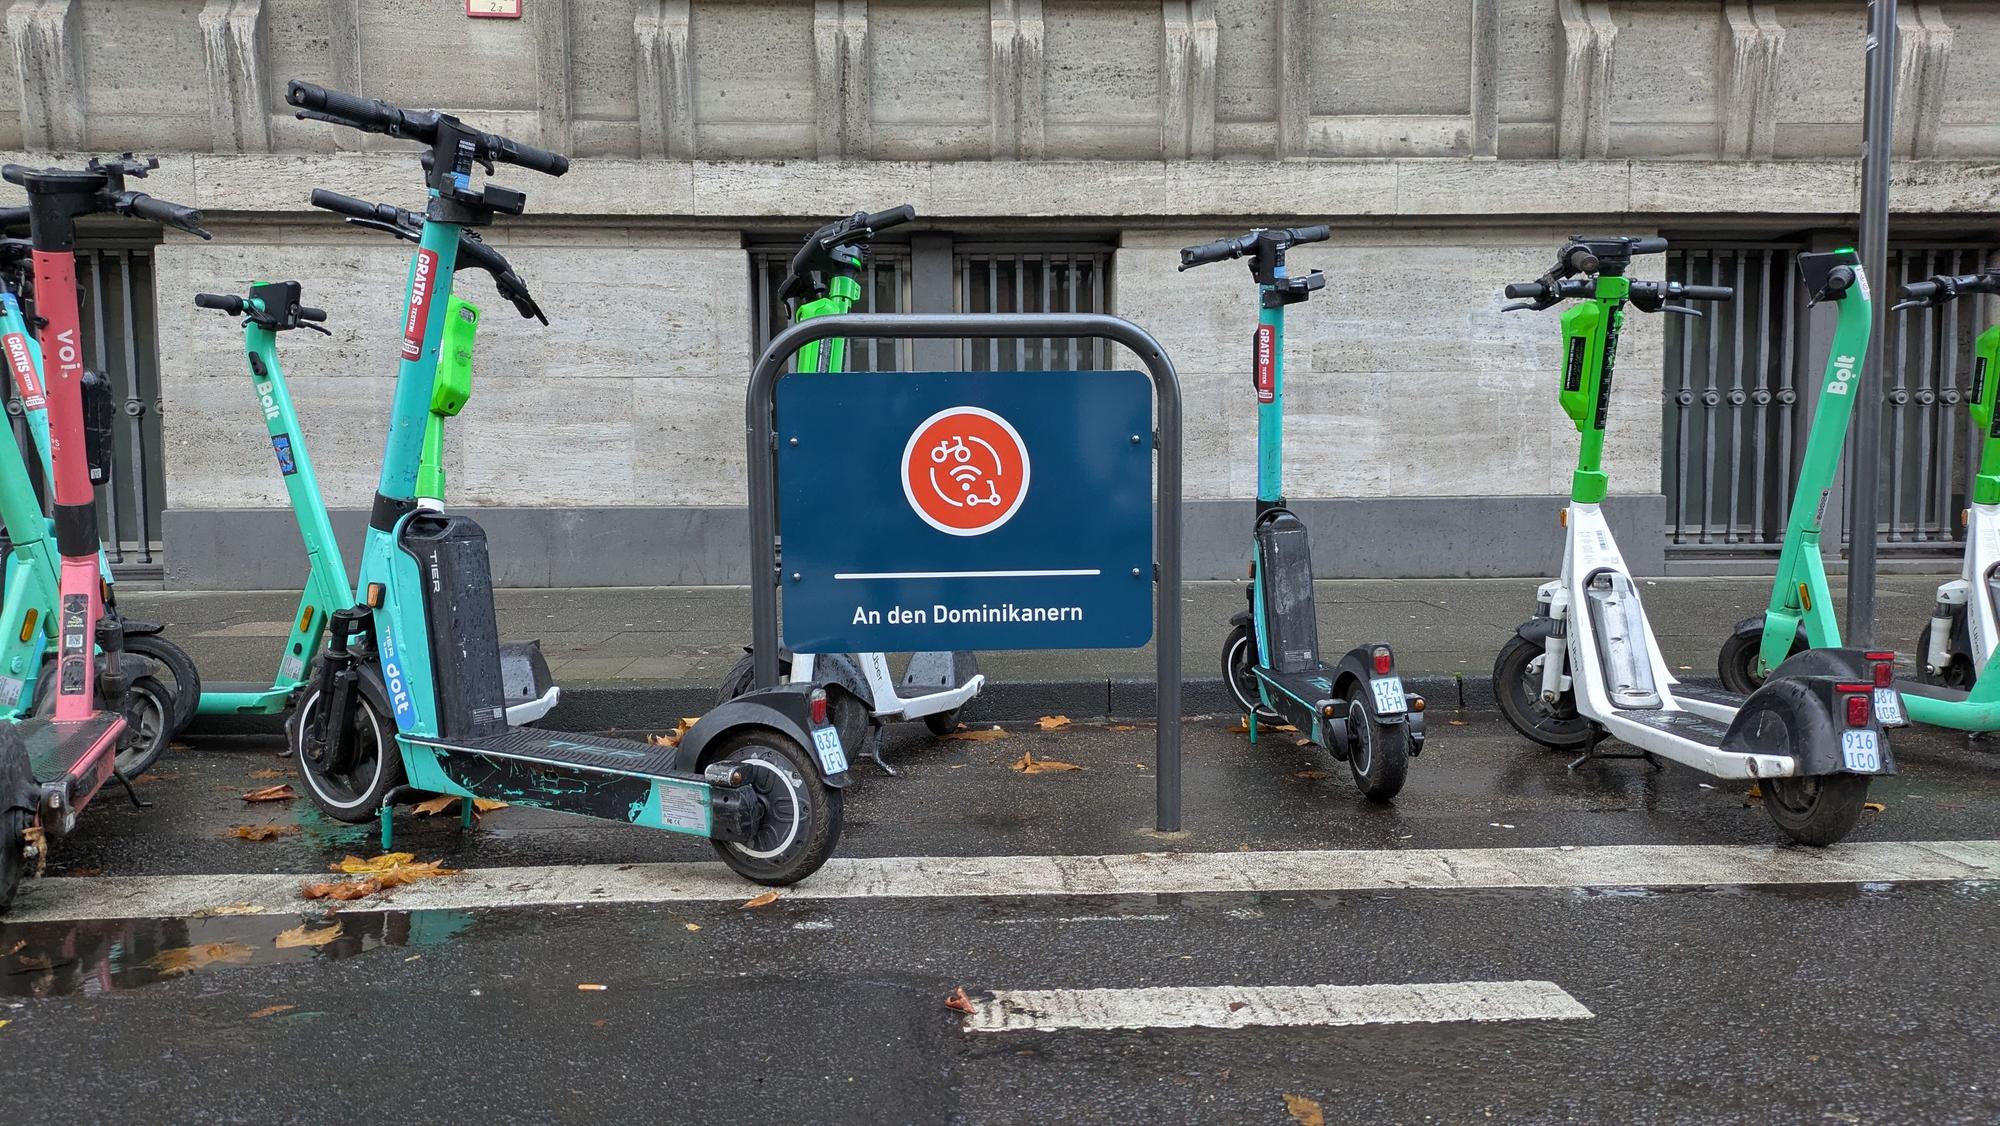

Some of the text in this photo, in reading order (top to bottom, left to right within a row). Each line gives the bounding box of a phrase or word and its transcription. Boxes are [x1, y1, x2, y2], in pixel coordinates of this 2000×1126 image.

[411, 253, 430, 306] GRATIS
[7, 336, 30, 373] GRATIS
[1260, 328, 1270, 366] GRATIS
[1826, 355, 1856, 395] Bolt
[257, 381, 280, 420] Bolt
[429, 550, 441, 593] TIER
[852, 603, 1083, 625] An den Dominikanern
[385, 625, 394, 657] TIER
[386, 663, 409, 715] dott
[1375, 680, 1399, 696] 174
[816, 731, 838, 751] 832
[1845, 733, 1873, 750] 916
[823, 751, 844, 772] IFJ
[1849, 752, 1876, 769] ICO
